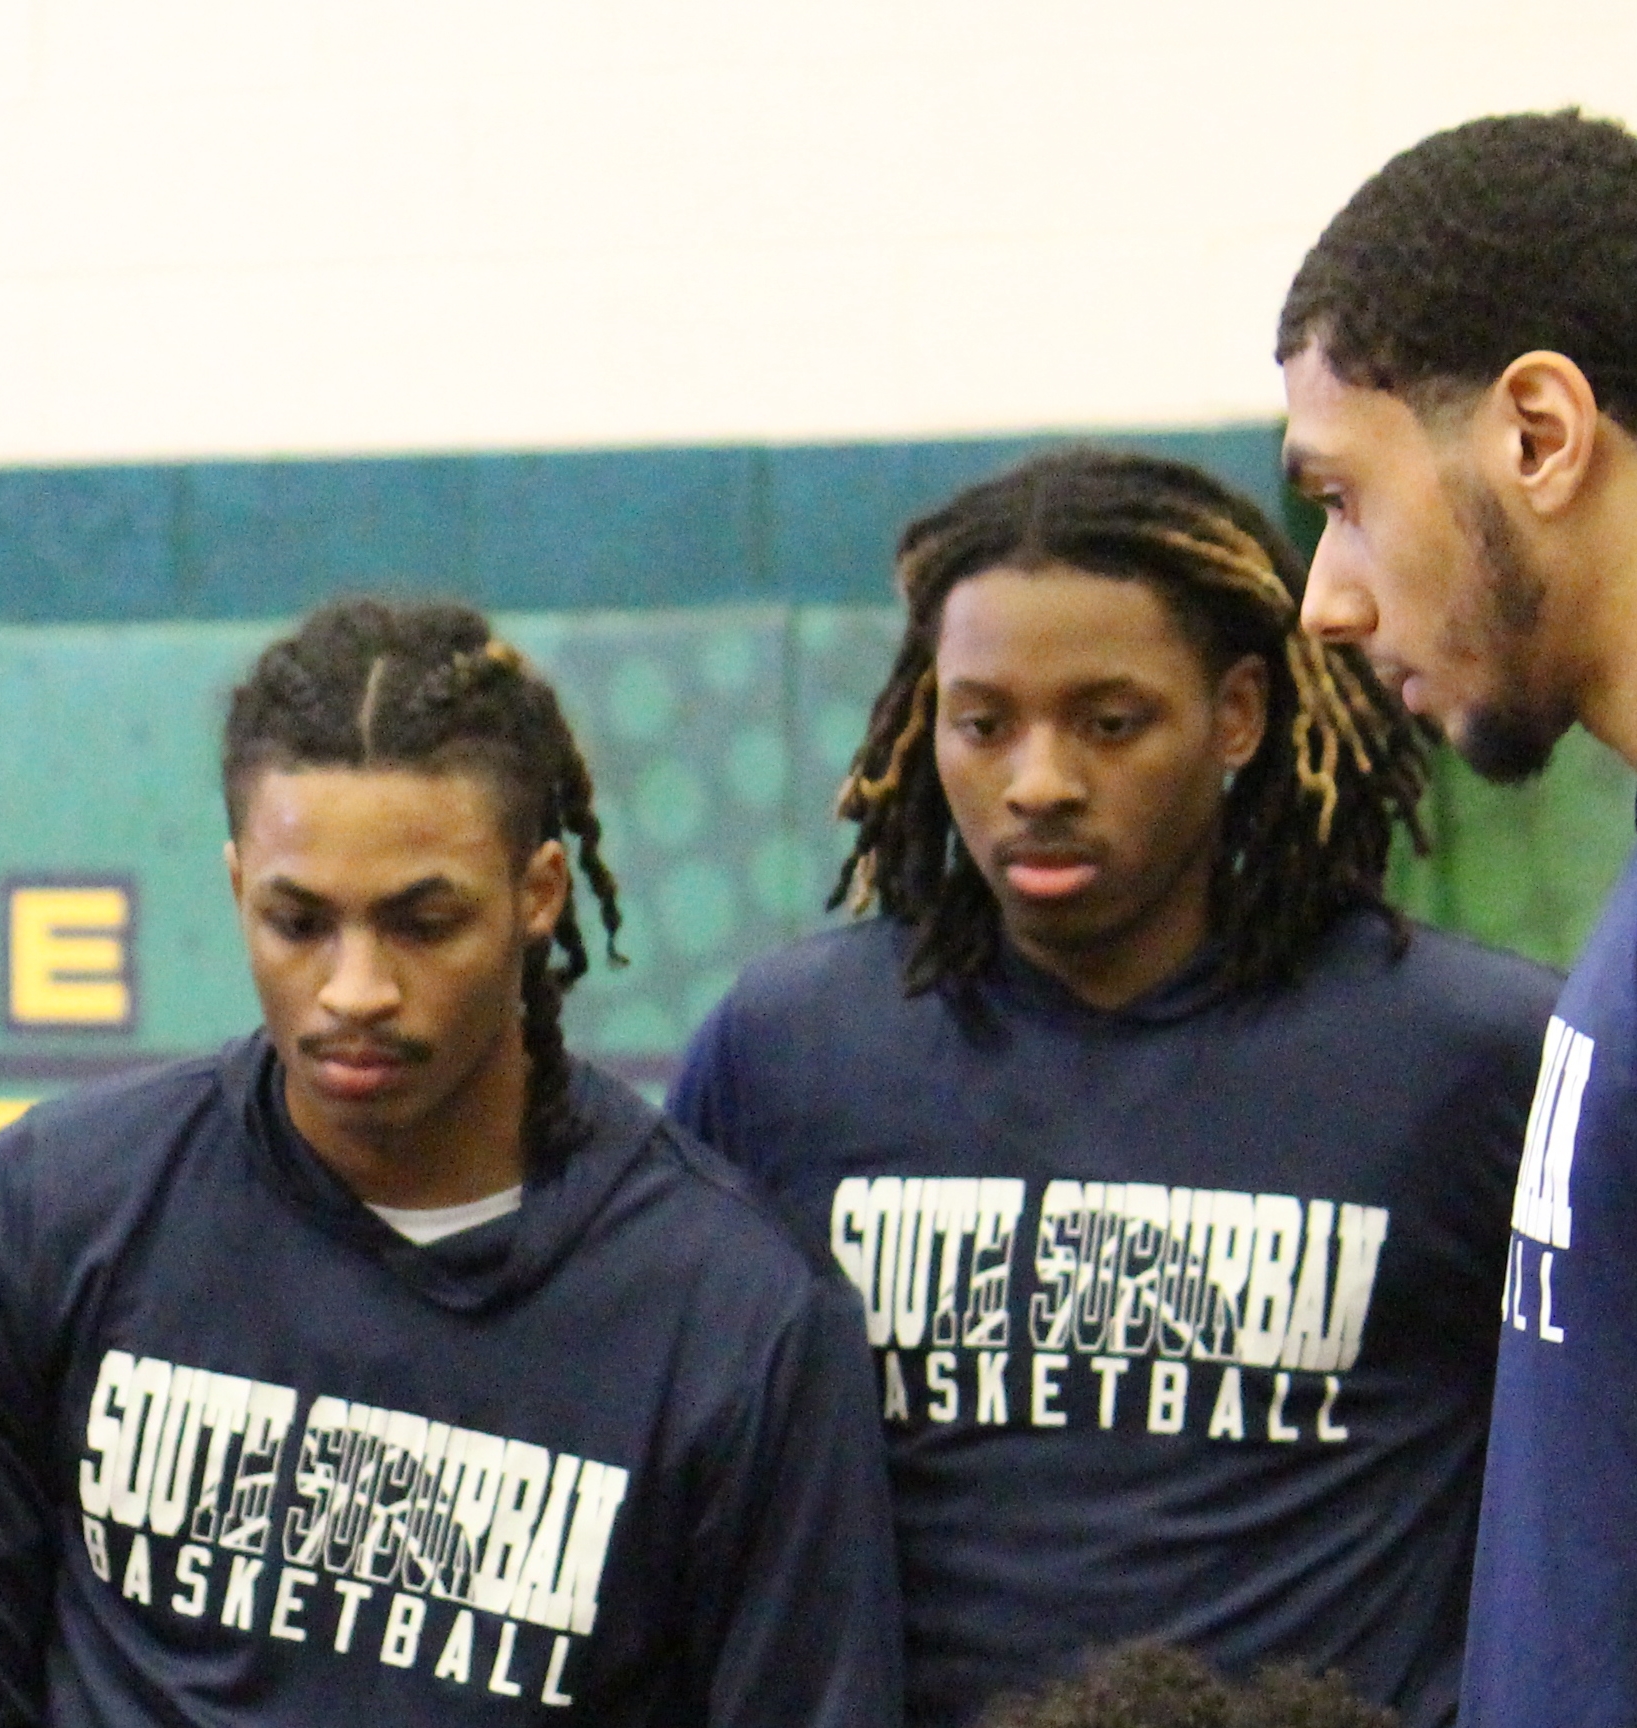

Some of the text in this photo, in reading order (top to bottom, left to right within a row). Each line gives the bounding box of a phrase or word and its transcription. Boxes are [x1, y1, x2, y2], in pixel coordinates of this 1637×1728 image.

[831, 1177, 1389, 1371] SOUTH SUBURBAN
[80, 1350, 629, 1635] SOUTH SUBURBAN
[882, 1350, 1349, 1442] ASKETBALL
[83, 1514, 573, 1706] BASKETBALL
